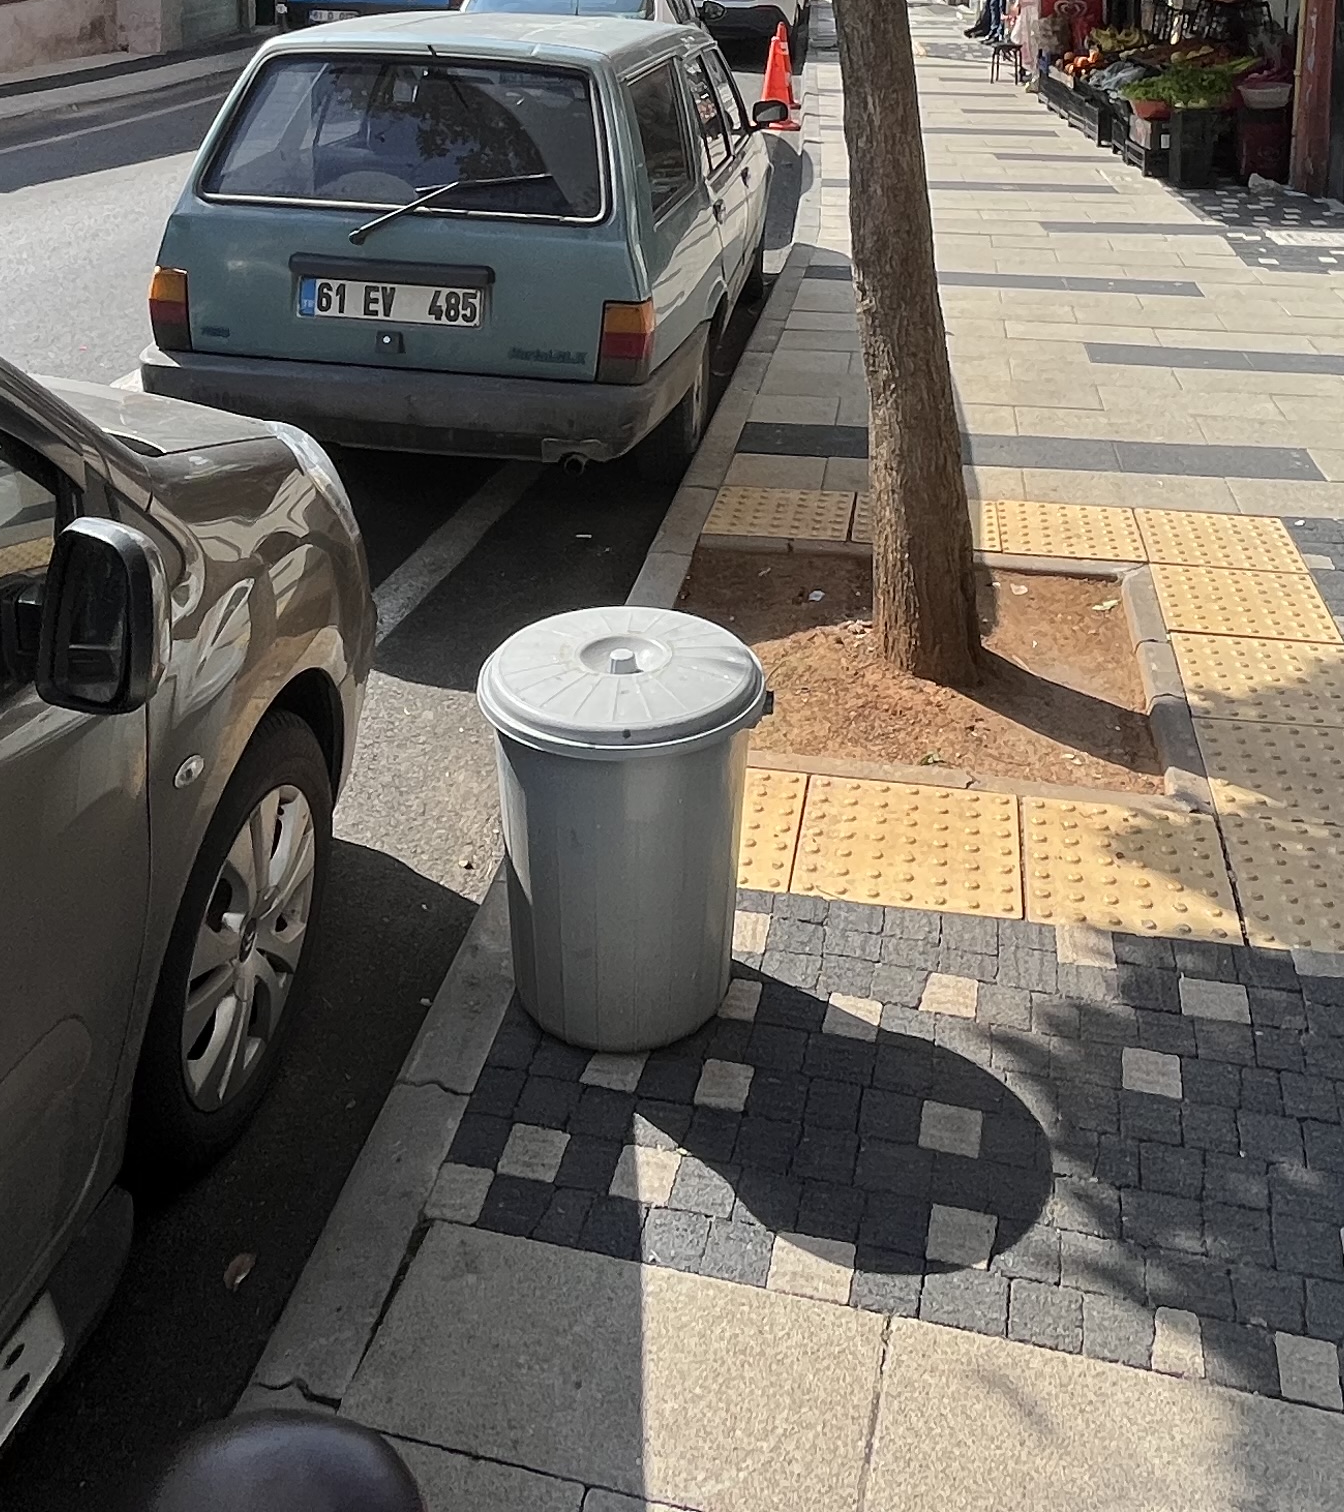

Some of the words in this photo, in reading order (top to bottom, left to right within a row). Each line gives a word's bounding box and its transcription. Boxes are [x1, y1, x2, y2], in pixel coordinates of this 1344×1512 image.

[317, 282, 347, 314] 61
[363, 285, 397, 318] EV
[427, 289, 478, 324] 485
